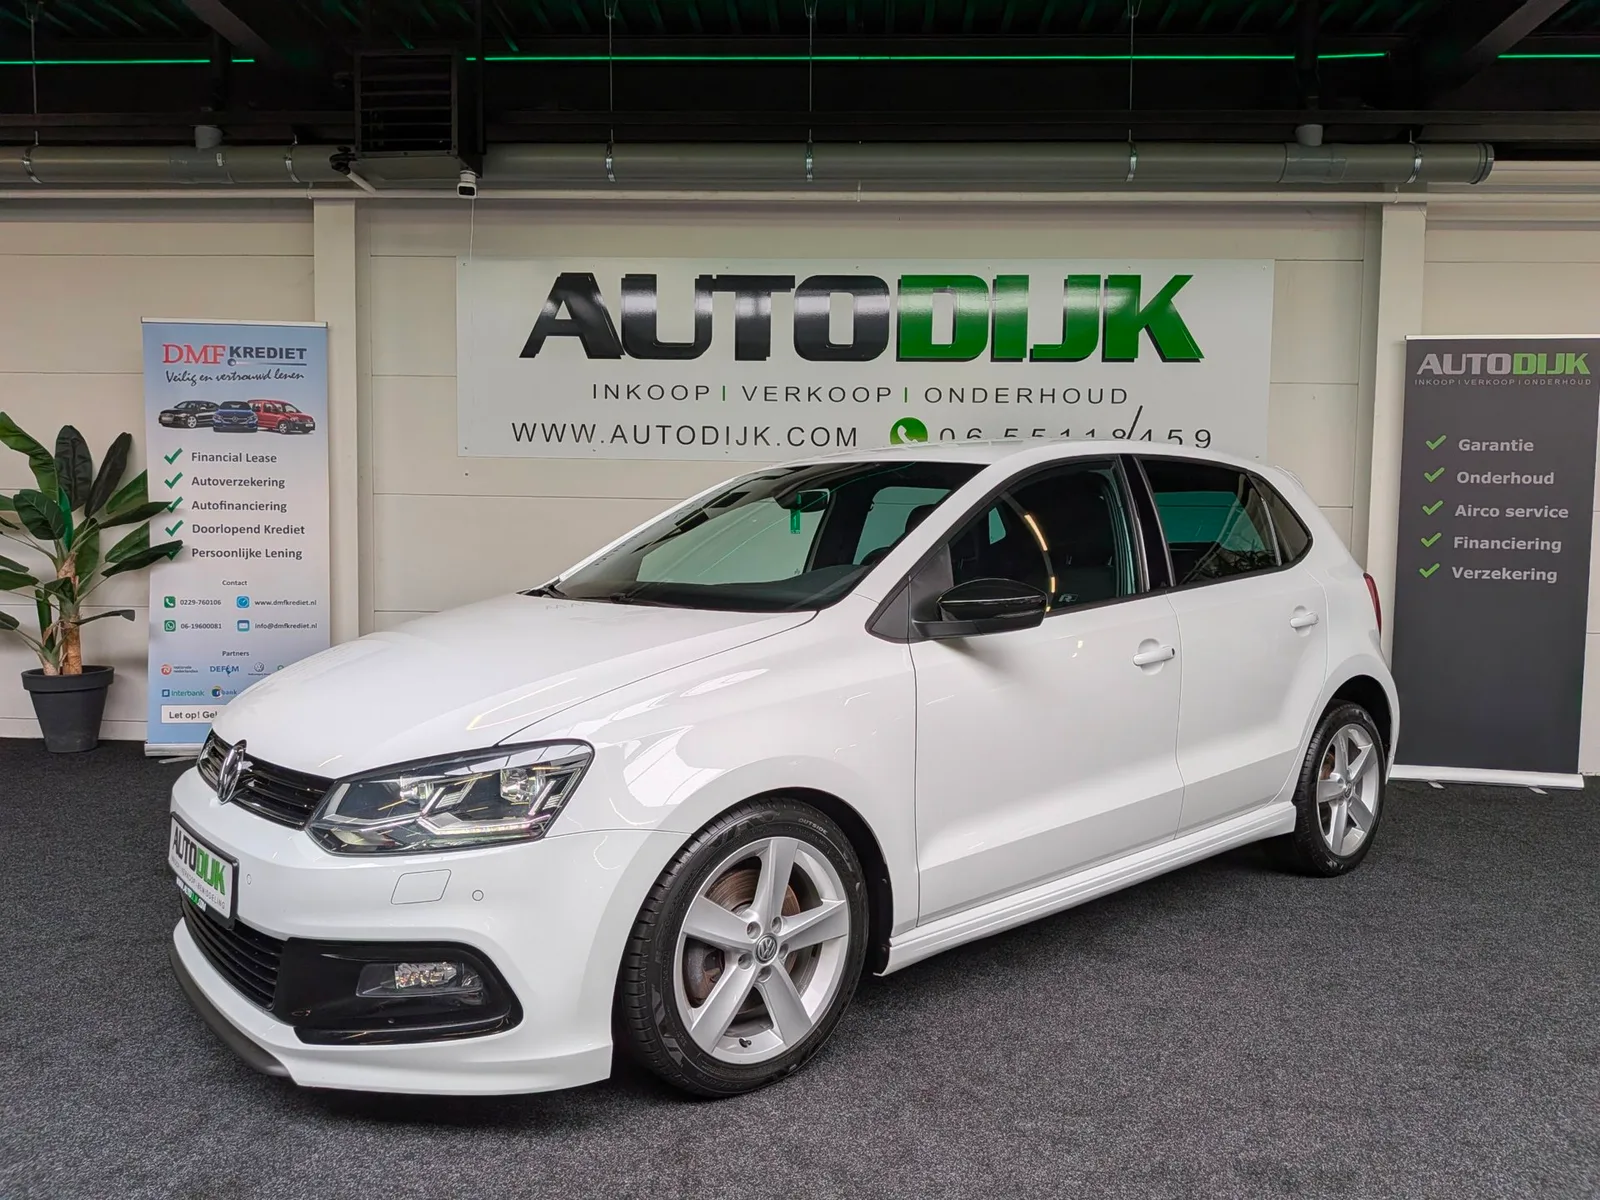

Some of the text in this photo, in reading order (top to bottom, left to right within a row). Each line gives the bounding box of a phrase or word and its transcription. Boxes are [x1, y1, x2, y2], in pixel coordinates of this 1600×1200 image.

[519, 272, 1204, 362] AUTODIJK
[162, 344, 307, 364] DMF KREDIET
[1417, 353, 1590, 375] AUTODIJK
[166, 370, 197, 386] Veilig
[215, 369, 271, 381] vertrouwd
[274, 368, 304, 379] lenen
[593, 384, 1128, 405] INKOOP VERKOOP ONDERHOUD
[511, 422, 857, 447] WWW.AUTODIJK.COM
[1458, 438, 1534, 452] Garantie
[191, 452, 277, 463] Financial Lease
[191, 476, 285, 488] Autoverzekering
[1456, 471, 1555, 485] Onderhoud
[191, 500, 287, 513] Autofinanciering
[1454, 504, 1569, 519] Airco service
[192, 524, 305, 537] Doorlopend Krediet
[1453, 536, 1562, 553] Financiering
[191, 548, 303, 560] Persoonlijke Lening
[1451, 566, 1558, 583] Verzekering
[254, 622, 318, 630] info@dmfkrediet.nl
[169, 711, 183, 719] Let
[185, 711, 200, 720] op!
[798, 817, 829, 836] OUTSIDE
